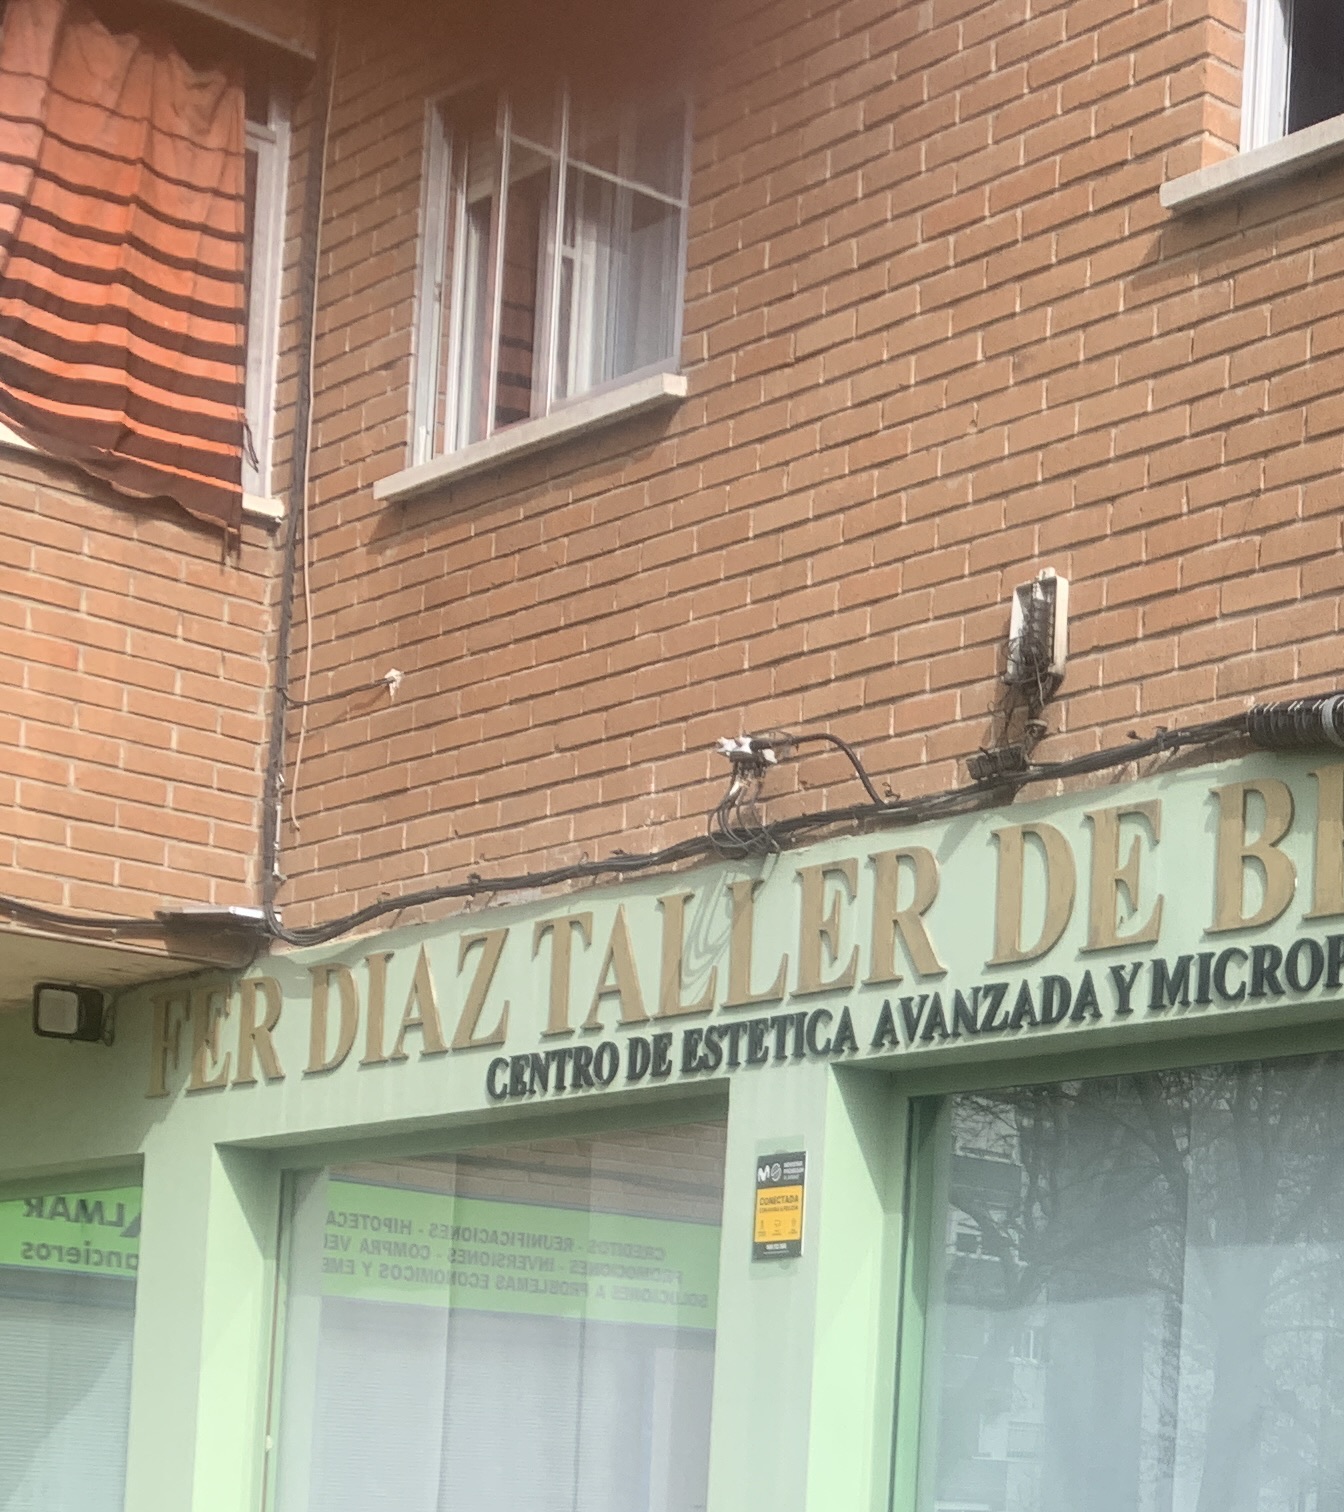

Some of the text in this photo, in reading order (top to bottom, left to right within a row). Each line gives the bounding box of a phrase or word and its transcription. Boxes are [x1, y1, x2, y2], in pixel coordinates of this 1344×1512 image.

[145, 975, 286, 1098] FER
[302, 926, 511, 1076] DIAZ
[534, 844, 948, 1037] TALLER
[986, 798, 1165, 968] DE
[486, 1040, 620, 1100] CENTRO
[626, 1031, 673, 1082] DE
[679, 1005, 860, 1074] ESTETICA
[870, 968, 1104, 1048] AVANZADA
[1109, 961, 1144, 1015] Y
